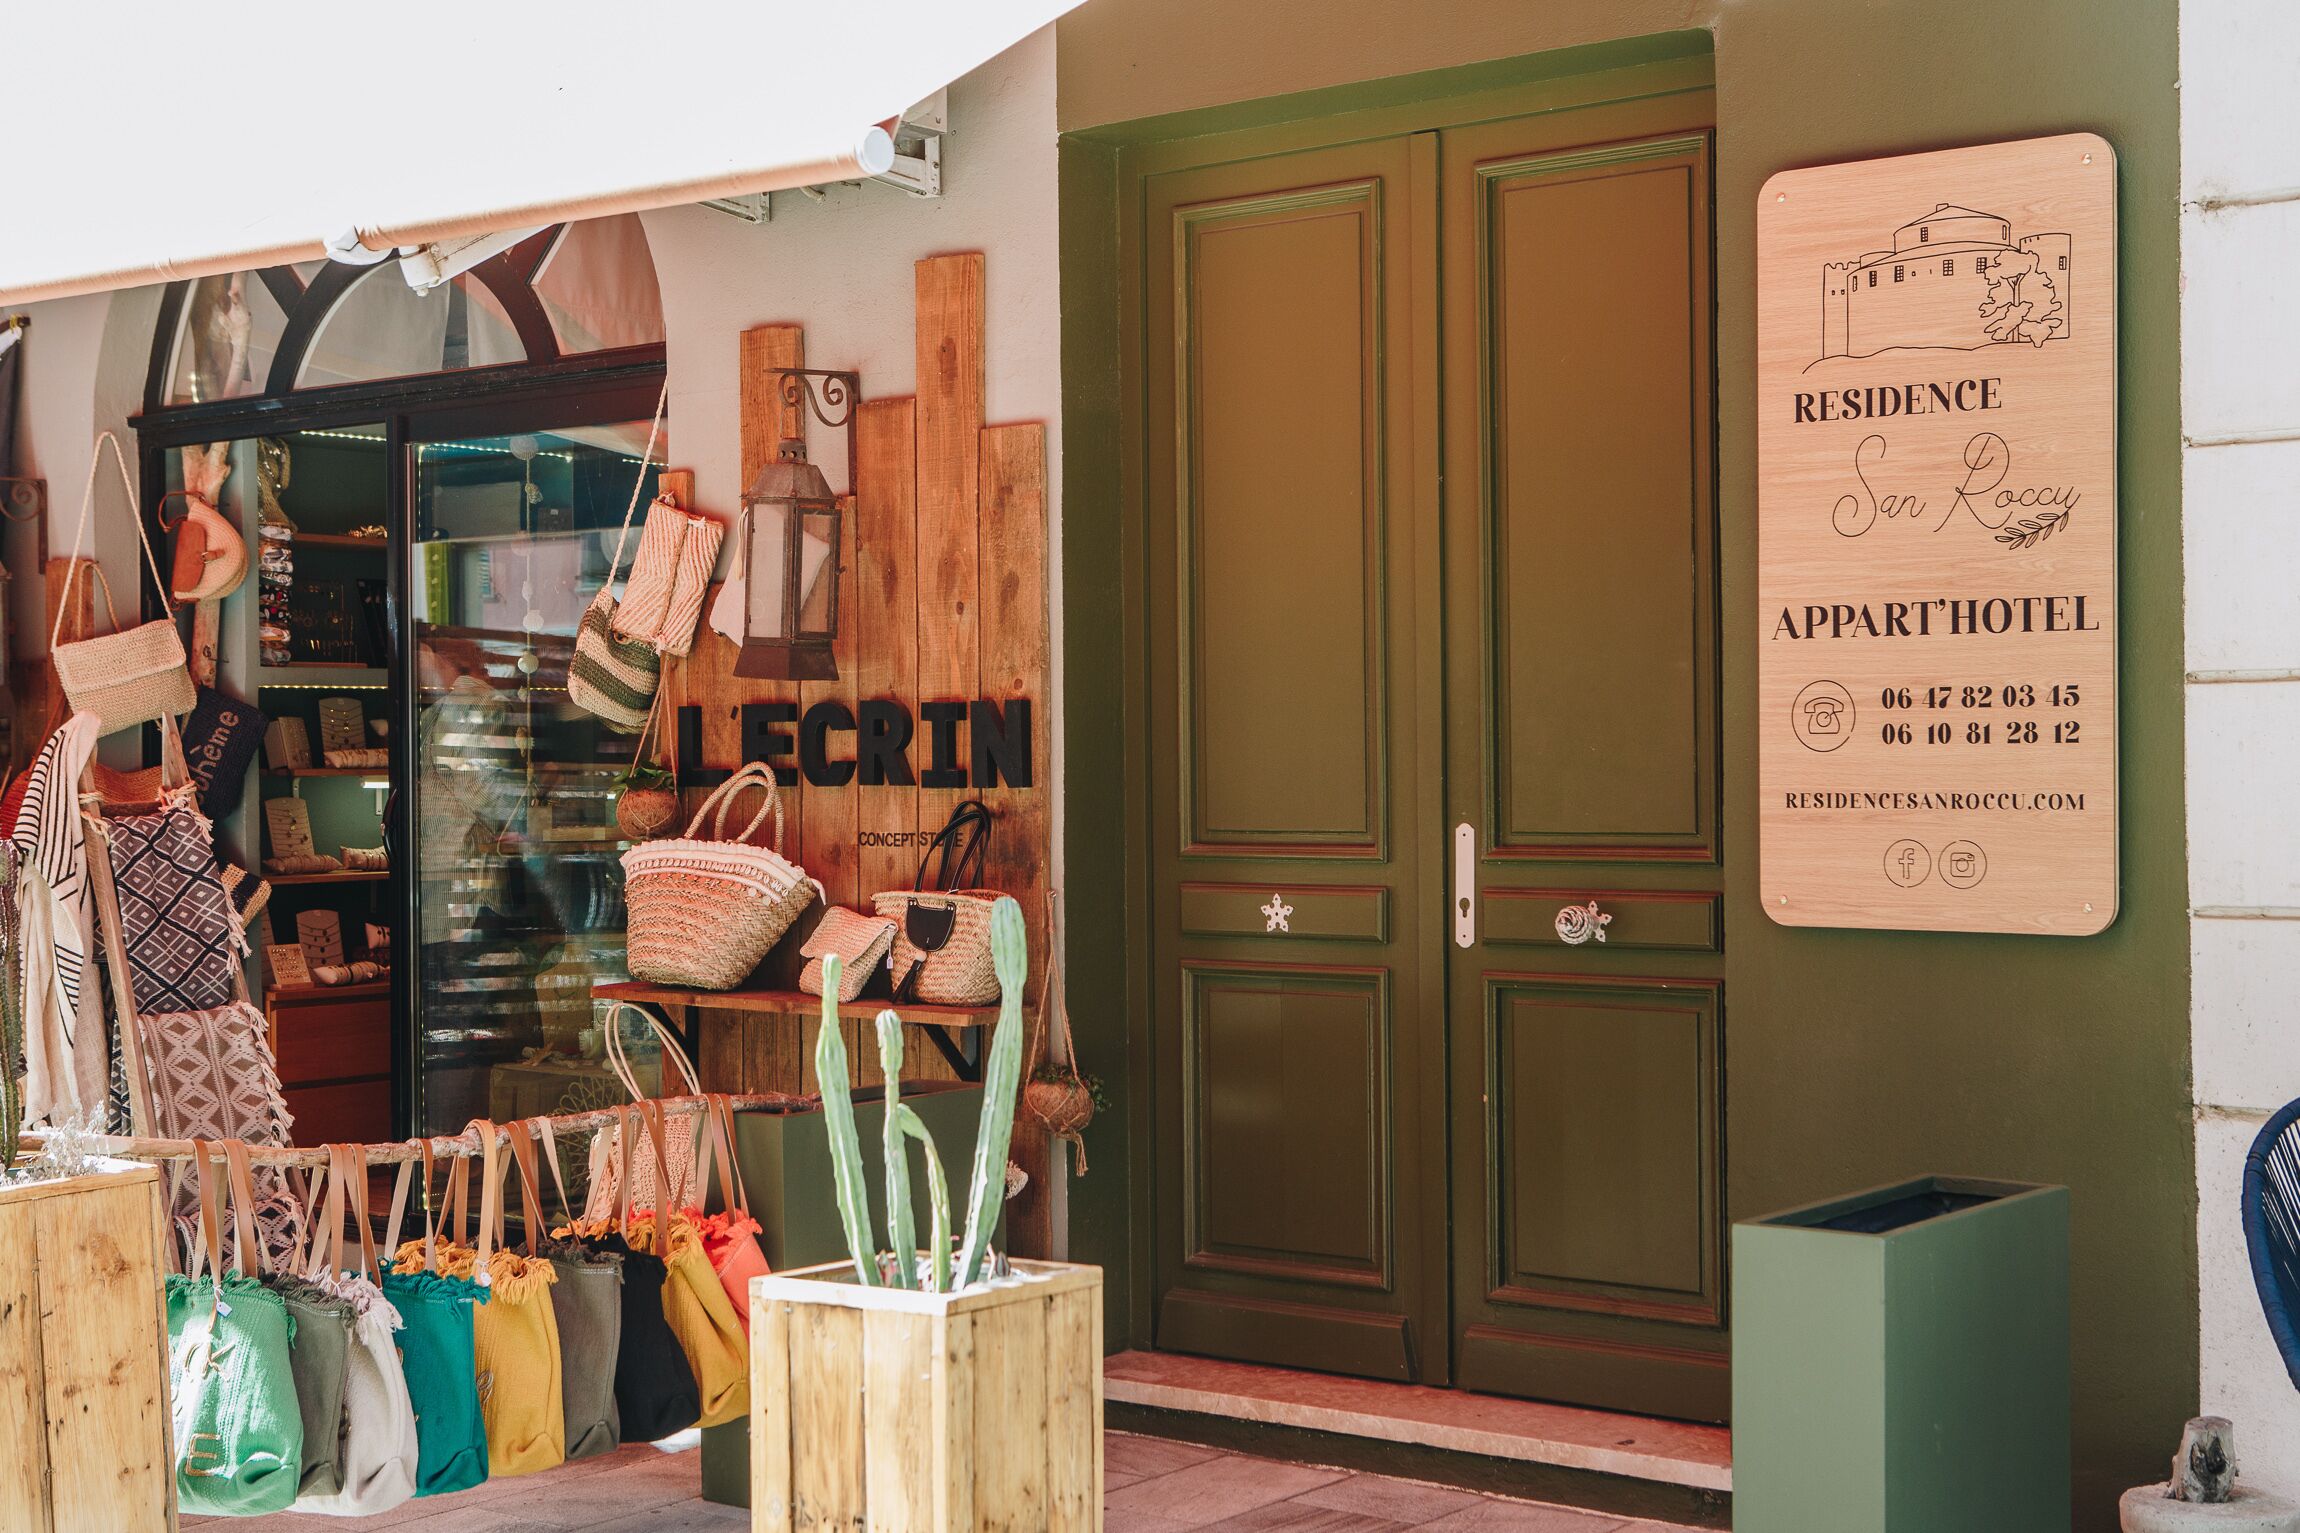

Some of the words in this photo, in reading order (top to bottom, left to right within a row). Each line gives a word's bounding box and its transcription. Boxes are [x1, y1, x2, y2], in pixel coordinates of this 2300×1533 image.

[1793, 377, 2002, 424] RESIDENCE
[1832, 434, 1927, 538] San
[1771, 595, 2100, 641] APPART'HOTEL
[1881, 687, 1913, 710] 06
[1922, 686, 1953, 709] 47
[1960, 685, 1993, 709] 82
[2002, 684, 2036, 708] 03
[2045, 684, 2081, 708] 45
[677, 699, 1033, 789] L'ECRIN
[1881, 722, 1913, 745] 06
[1927, 722, 1952, 745] 10
[1965, 721, 1992, 745] 81
[2006, 721, 2039, 744] 28
[2053, 720, 2081, 744] 12
[187, 711, 240, 805] ohème
[1784, 792, 2086, 811] RESIDENCESANROCCU.COM
[858, 831, 917, 848] CONCEPT
